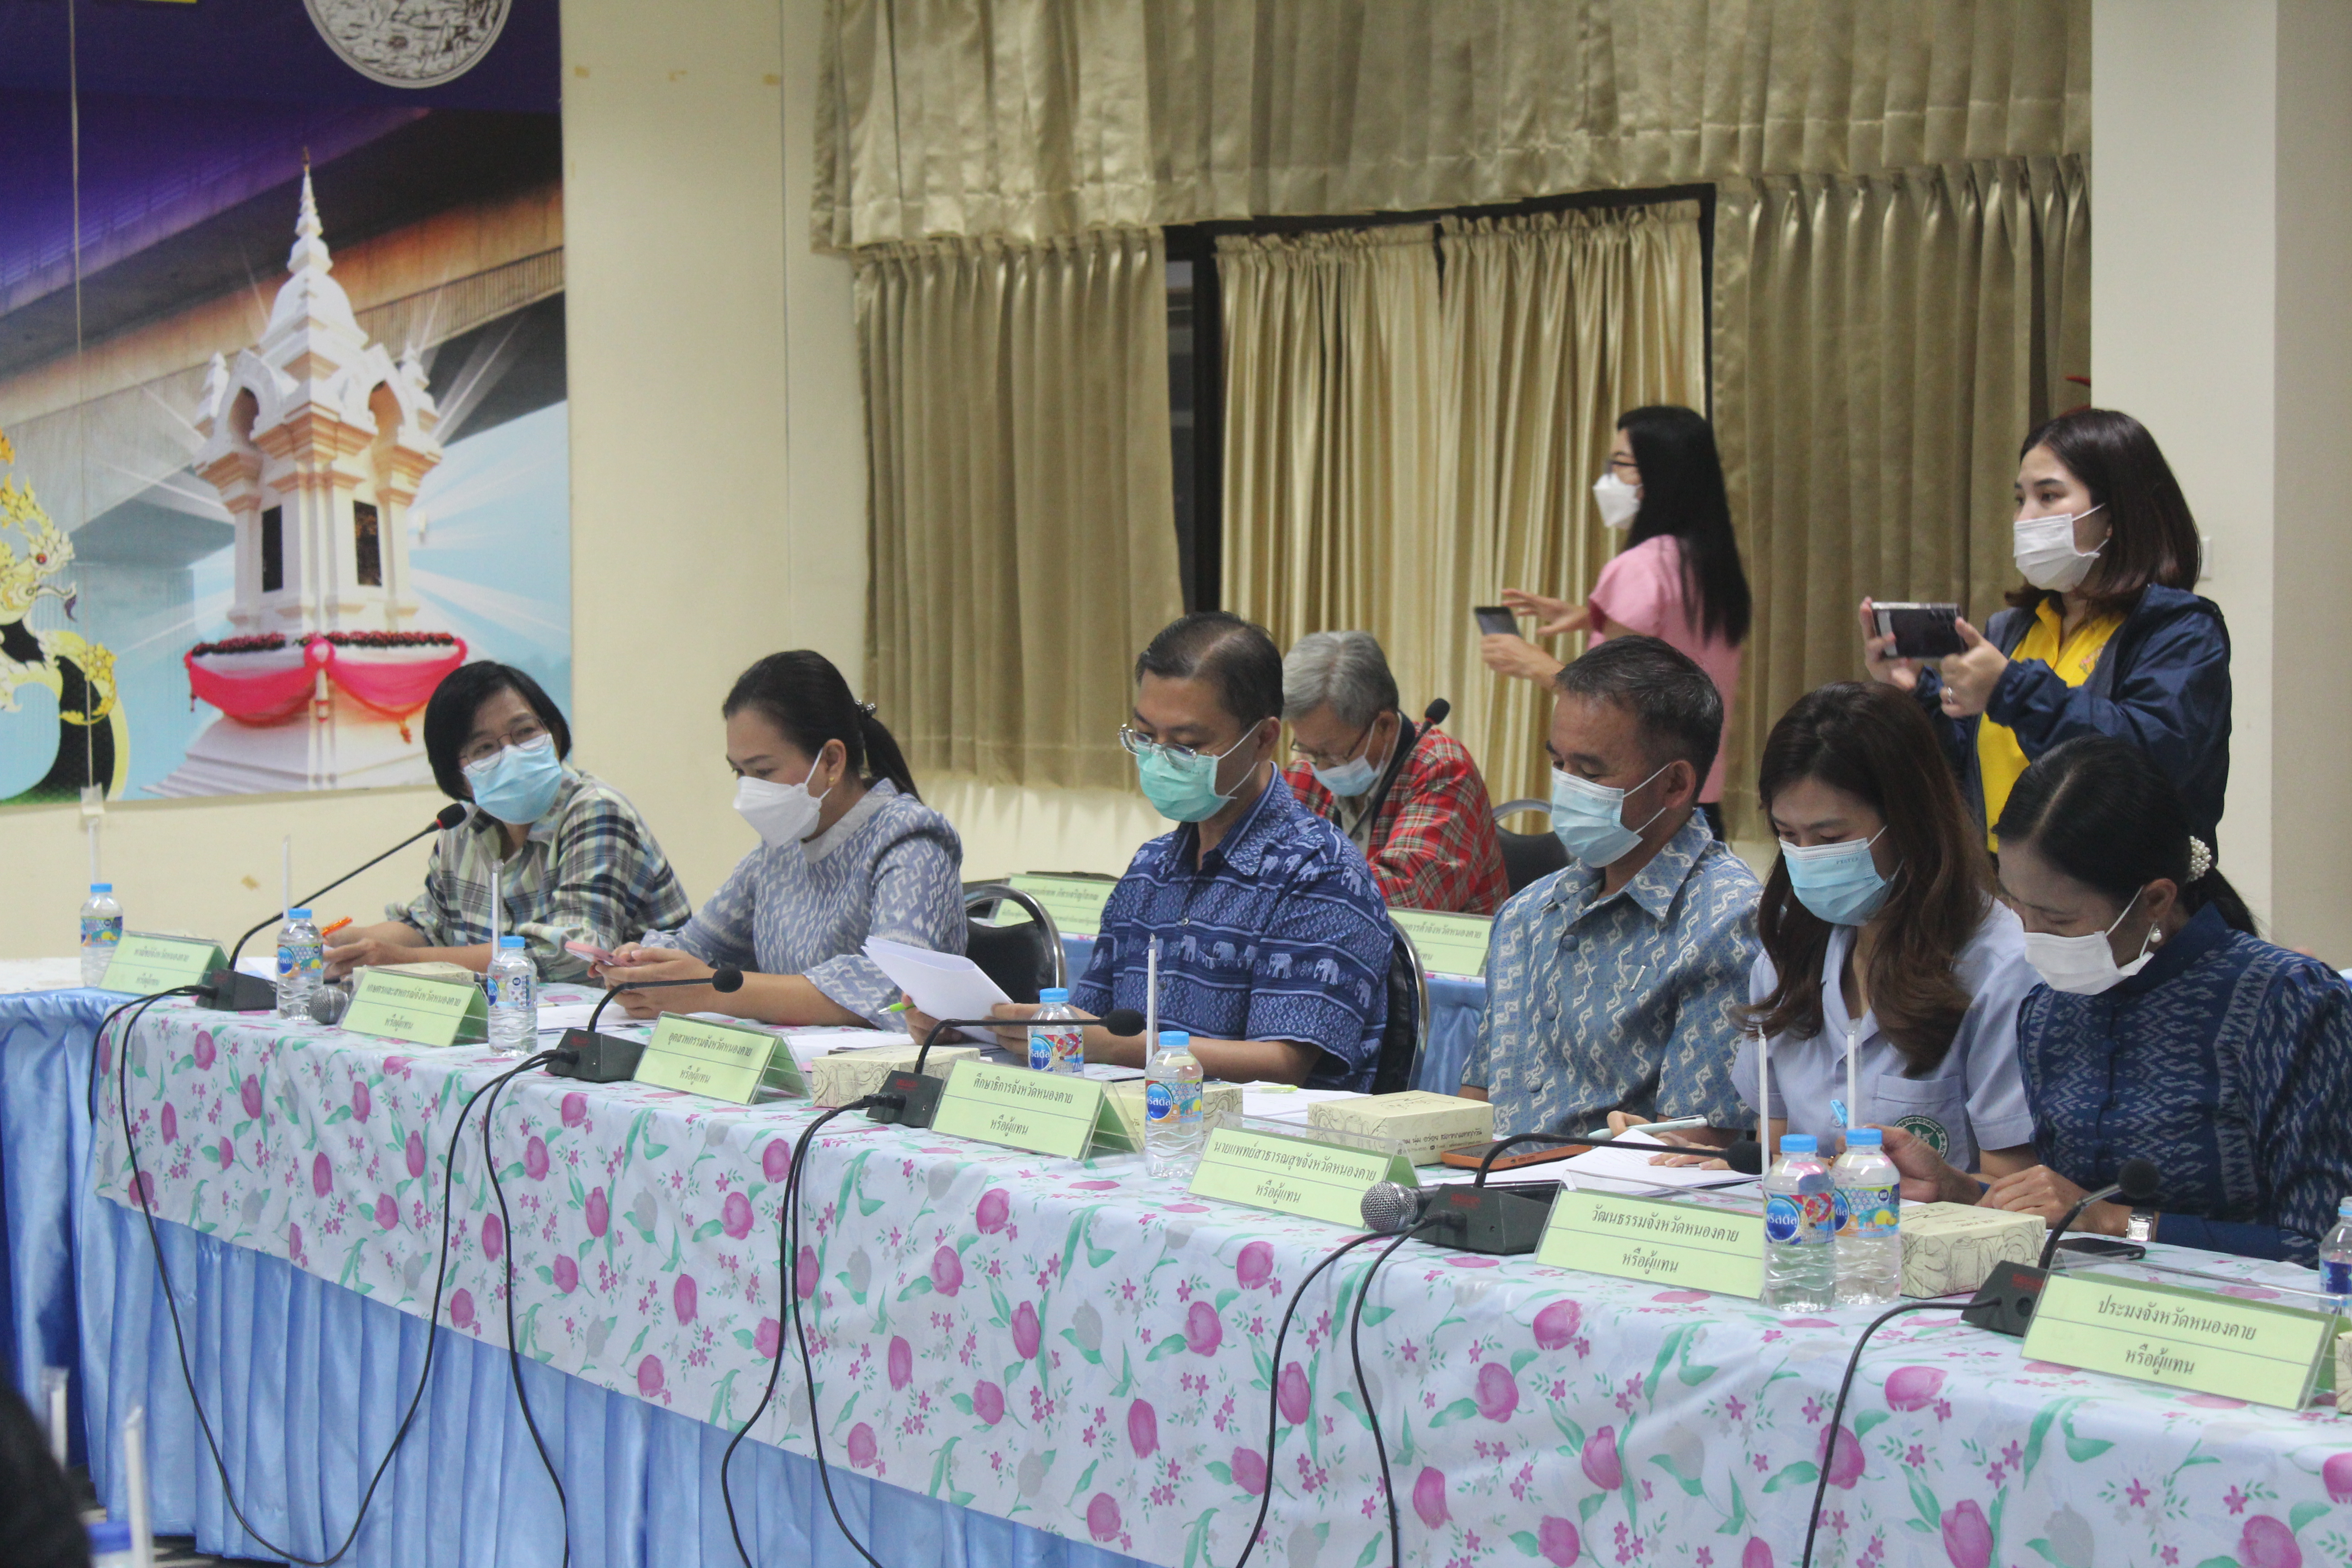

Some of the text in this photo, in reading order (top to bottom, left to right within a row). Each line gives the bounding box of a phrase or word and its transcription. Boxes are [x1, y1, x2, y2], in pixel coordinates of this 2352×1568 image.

[384, 1014, 414, 1031] หรือผู้แทน
[680, 1065, 711, 1085] หรือผู้แทน
[973, 1073, 1074, 1104] ศึกษาธิการจังหวัดหนองคาย
[990, 1114, 1029, 1137] หรือผู้แทน
[1213, 1141, 1377, 1181] นายแพทย์สาธารณสุขจังหวัดหนองคาย
[1255, 1180, 1301, 1204] หรือผู้แทน
[1592, 1204, 1740, 1243] วัฒนธรรมจังหวัดหนองคาย
[1622, 1247, 1679, 1274] หรือผู้แทน
[2097, 1294, 2257, 1341] ประมงจังหวัดหนองคาย
[2125, 1343, 2195, 1376] หรือผู้แทน
